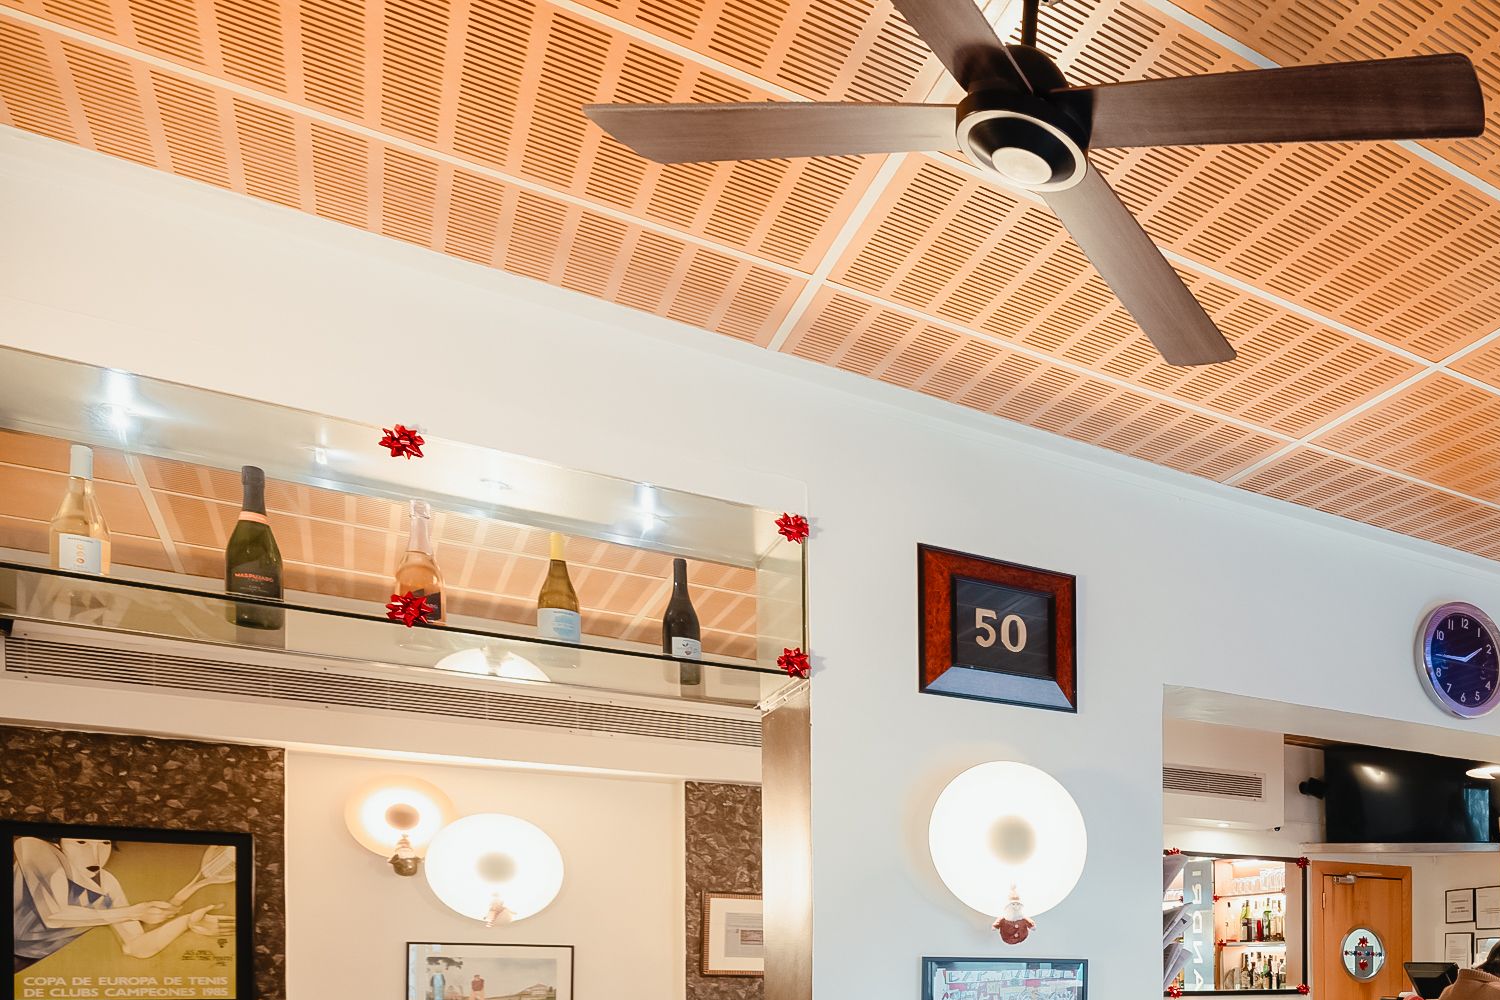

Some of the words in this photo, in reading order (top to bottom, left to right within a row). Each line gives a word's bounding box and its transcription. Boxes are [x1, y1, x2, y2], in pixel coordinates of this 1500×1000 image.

[1448, 619, 1454, 630] 11
[1461, 617, 1469, 629] 12
[975, 607, 1027, 653] 50
[1477, 627, 1481, 638] 1
[1436, 630, 1444, 641] 10
[1486, 644, 1492, 654] 2
[1436, 667, 1442, 677] 8
[1446, 683, 1452, 693] 7
[1485, 681, 1491, 690] 4
[1460, 693, 1466, 703] 6
[1475, 691, 1480, 701] 5
[24, 977, 67, 986] COPA
[72, 977, 92, 986] DE
[98, 976, 158, 985] EUROPA
[164, 976, 183, 985] DE
[188, 976, 228, 985] TENIS
[24, 988, 44, 997] DE
[50, 988, 98, 997] CLUBS
[104, 988, 196, 996] CAMPEONES
